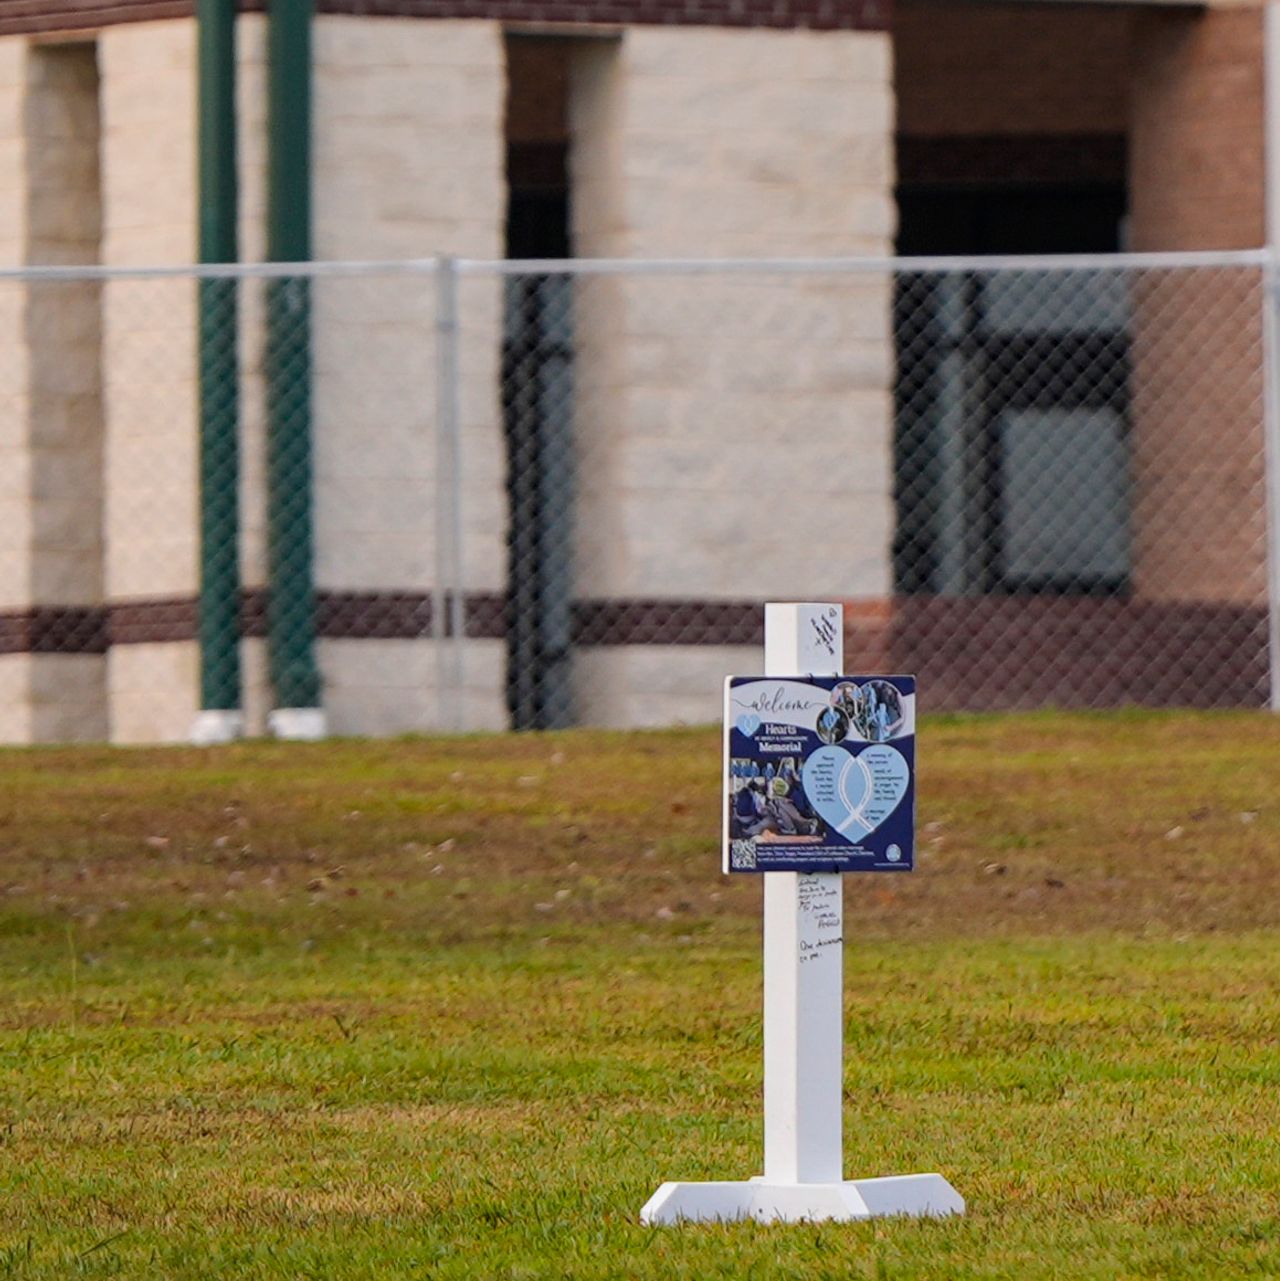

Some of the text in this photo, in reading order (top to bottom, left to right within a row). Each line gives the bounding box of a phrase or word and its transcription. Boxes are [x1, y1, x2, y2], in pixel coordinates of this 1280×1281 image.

[740, 687, 818, 713] welcome
[765, 723, 797, 735] Hearts
[759, 742, 803, 752] Memorial
